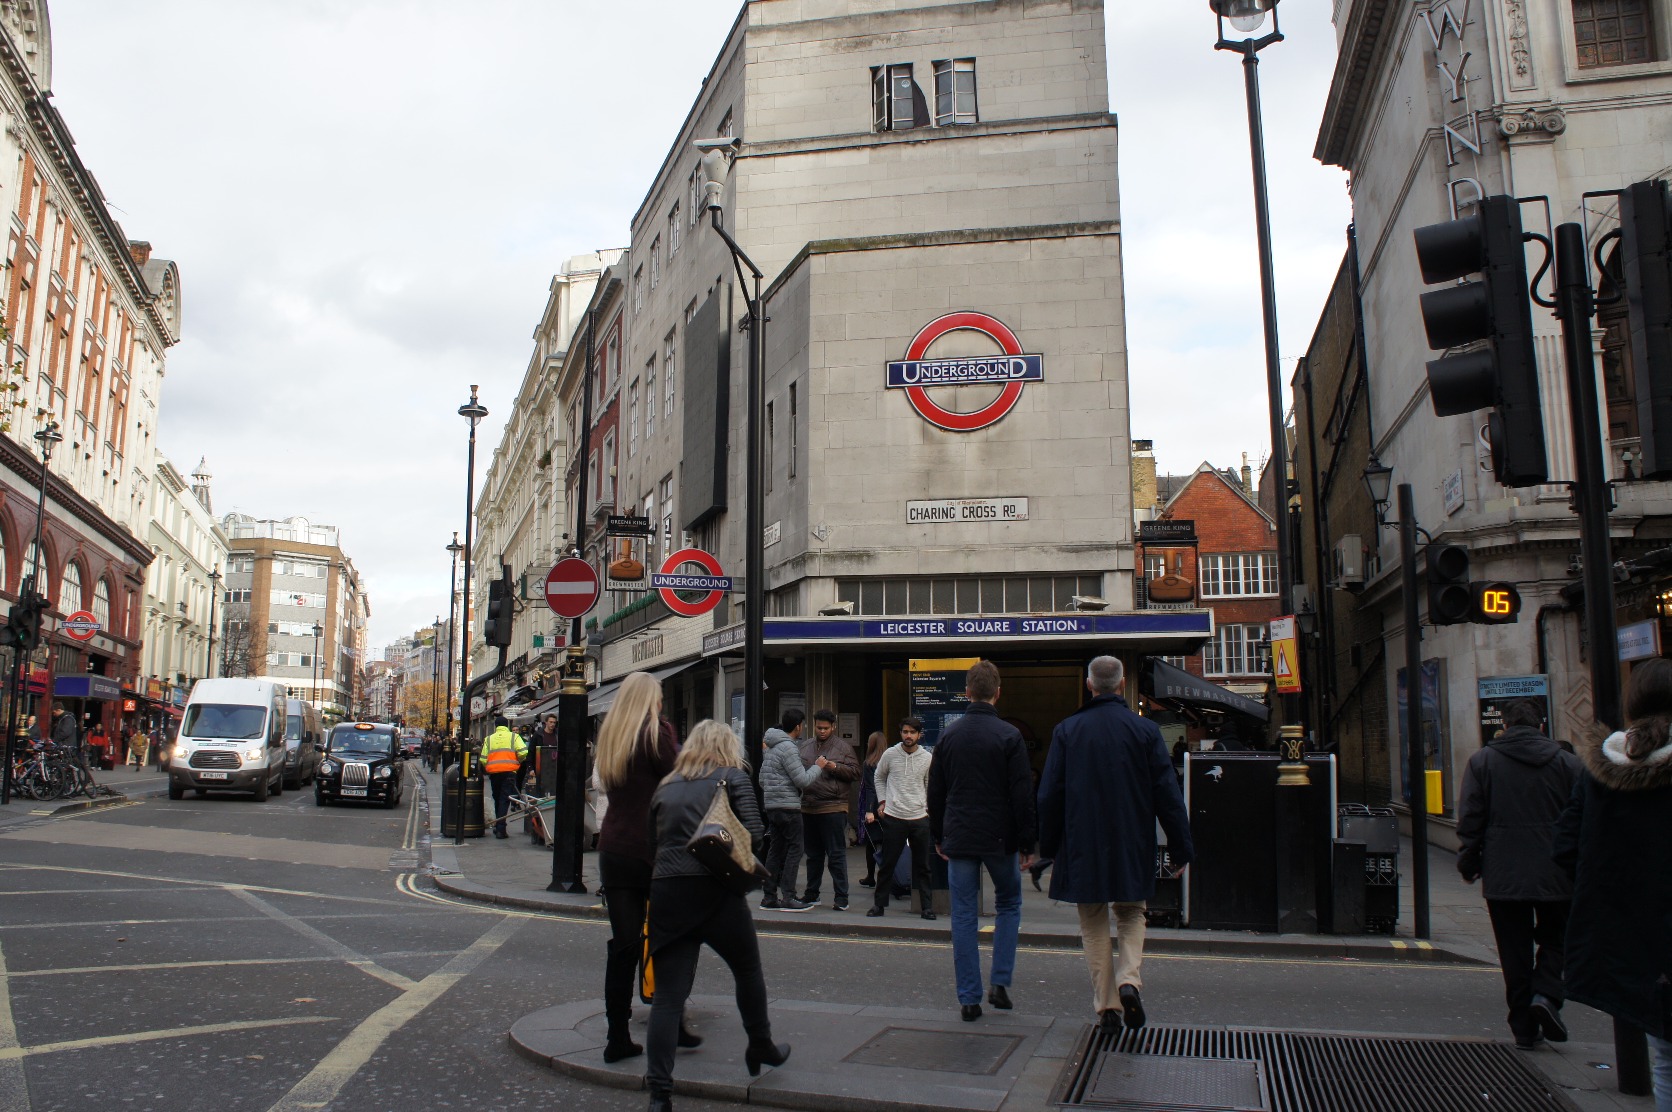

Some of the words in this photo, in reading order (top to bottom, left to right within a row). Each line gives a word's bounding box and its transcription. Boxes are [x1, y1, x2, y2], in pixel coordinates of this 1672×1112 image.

[902, 358, 1027, 383] UNDERGROUND
[909, 507, 956, 520] CHARING
[962, 505, 997, 518] CROSS
[654, 576, 729, 588] UNDERGROUND
[1484, 591, 1509, 613] 05
[880, 623, 946, 634] LEICESTER
[957, 621, 1010, 633] SQUARE
[1022, 620, 1078, 632] STATION
[1166, 685, 1247, 709] BREWMASTER
